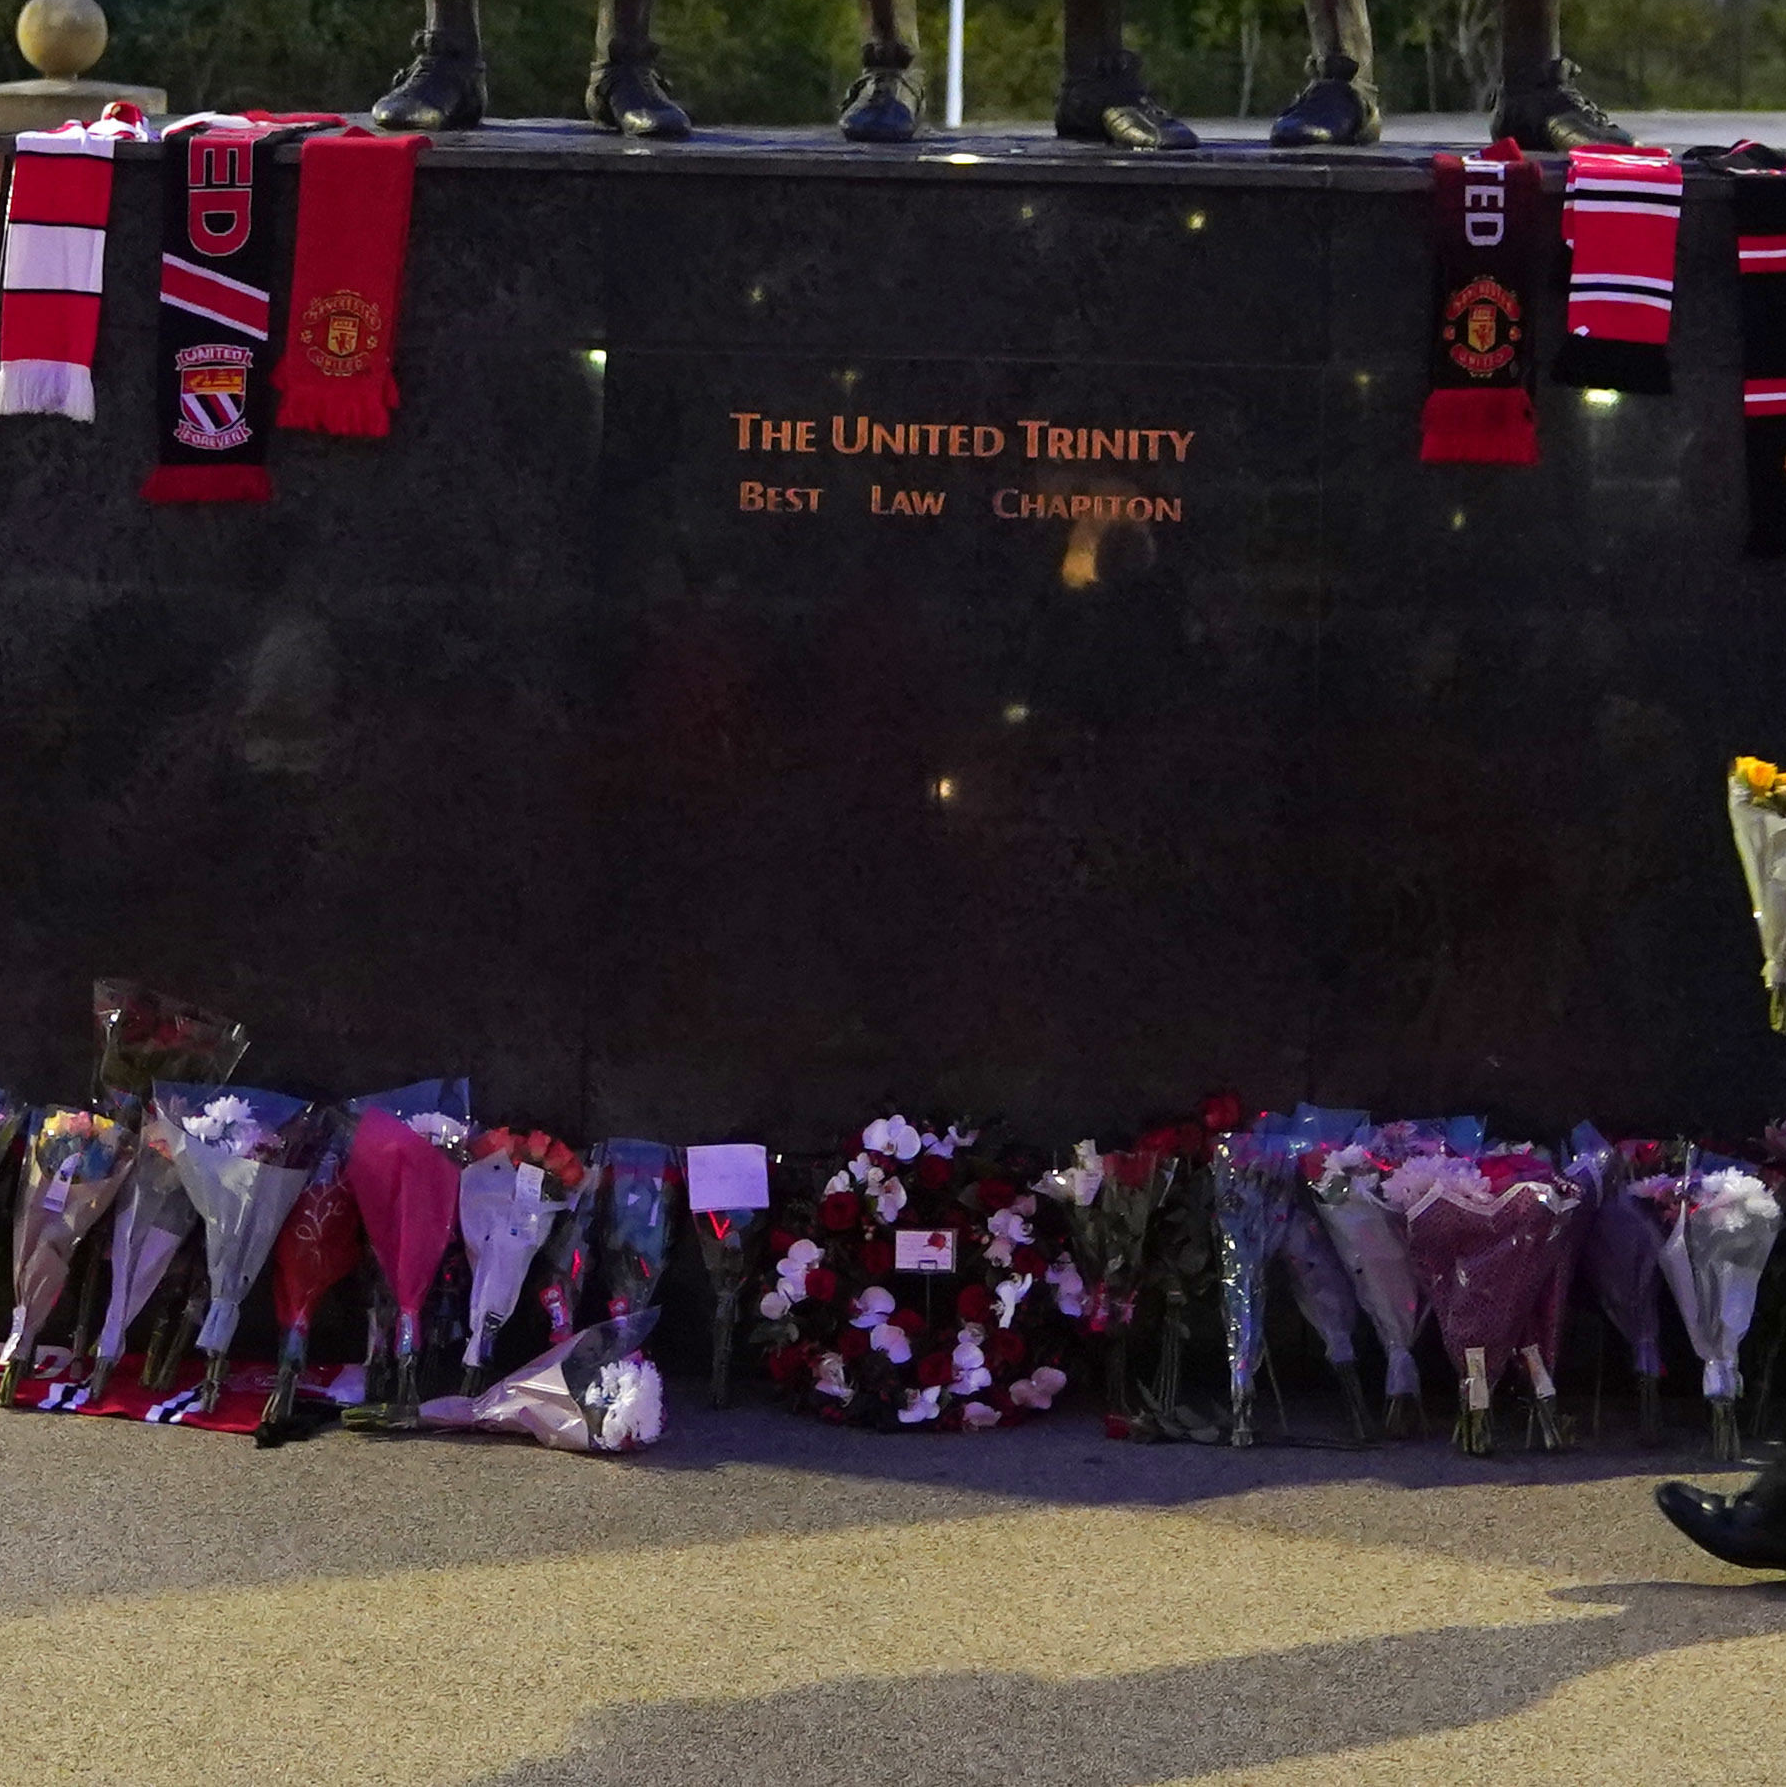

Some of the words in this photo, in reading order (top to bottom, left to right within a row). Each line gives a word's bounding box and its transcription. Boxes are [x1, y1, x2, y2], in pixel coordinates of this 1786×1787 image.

[183, 348, 243, 363] UNITED
[181, 426, 243, 448] FOREVER
[729, 412, 817, 454] THE
[832, 416, 1005, 457] UNITED
[1018, 420, 1195, 462] TRINITY
[738, 480, 823, 514] BEST
[870, 484, 946, 517] LAW
